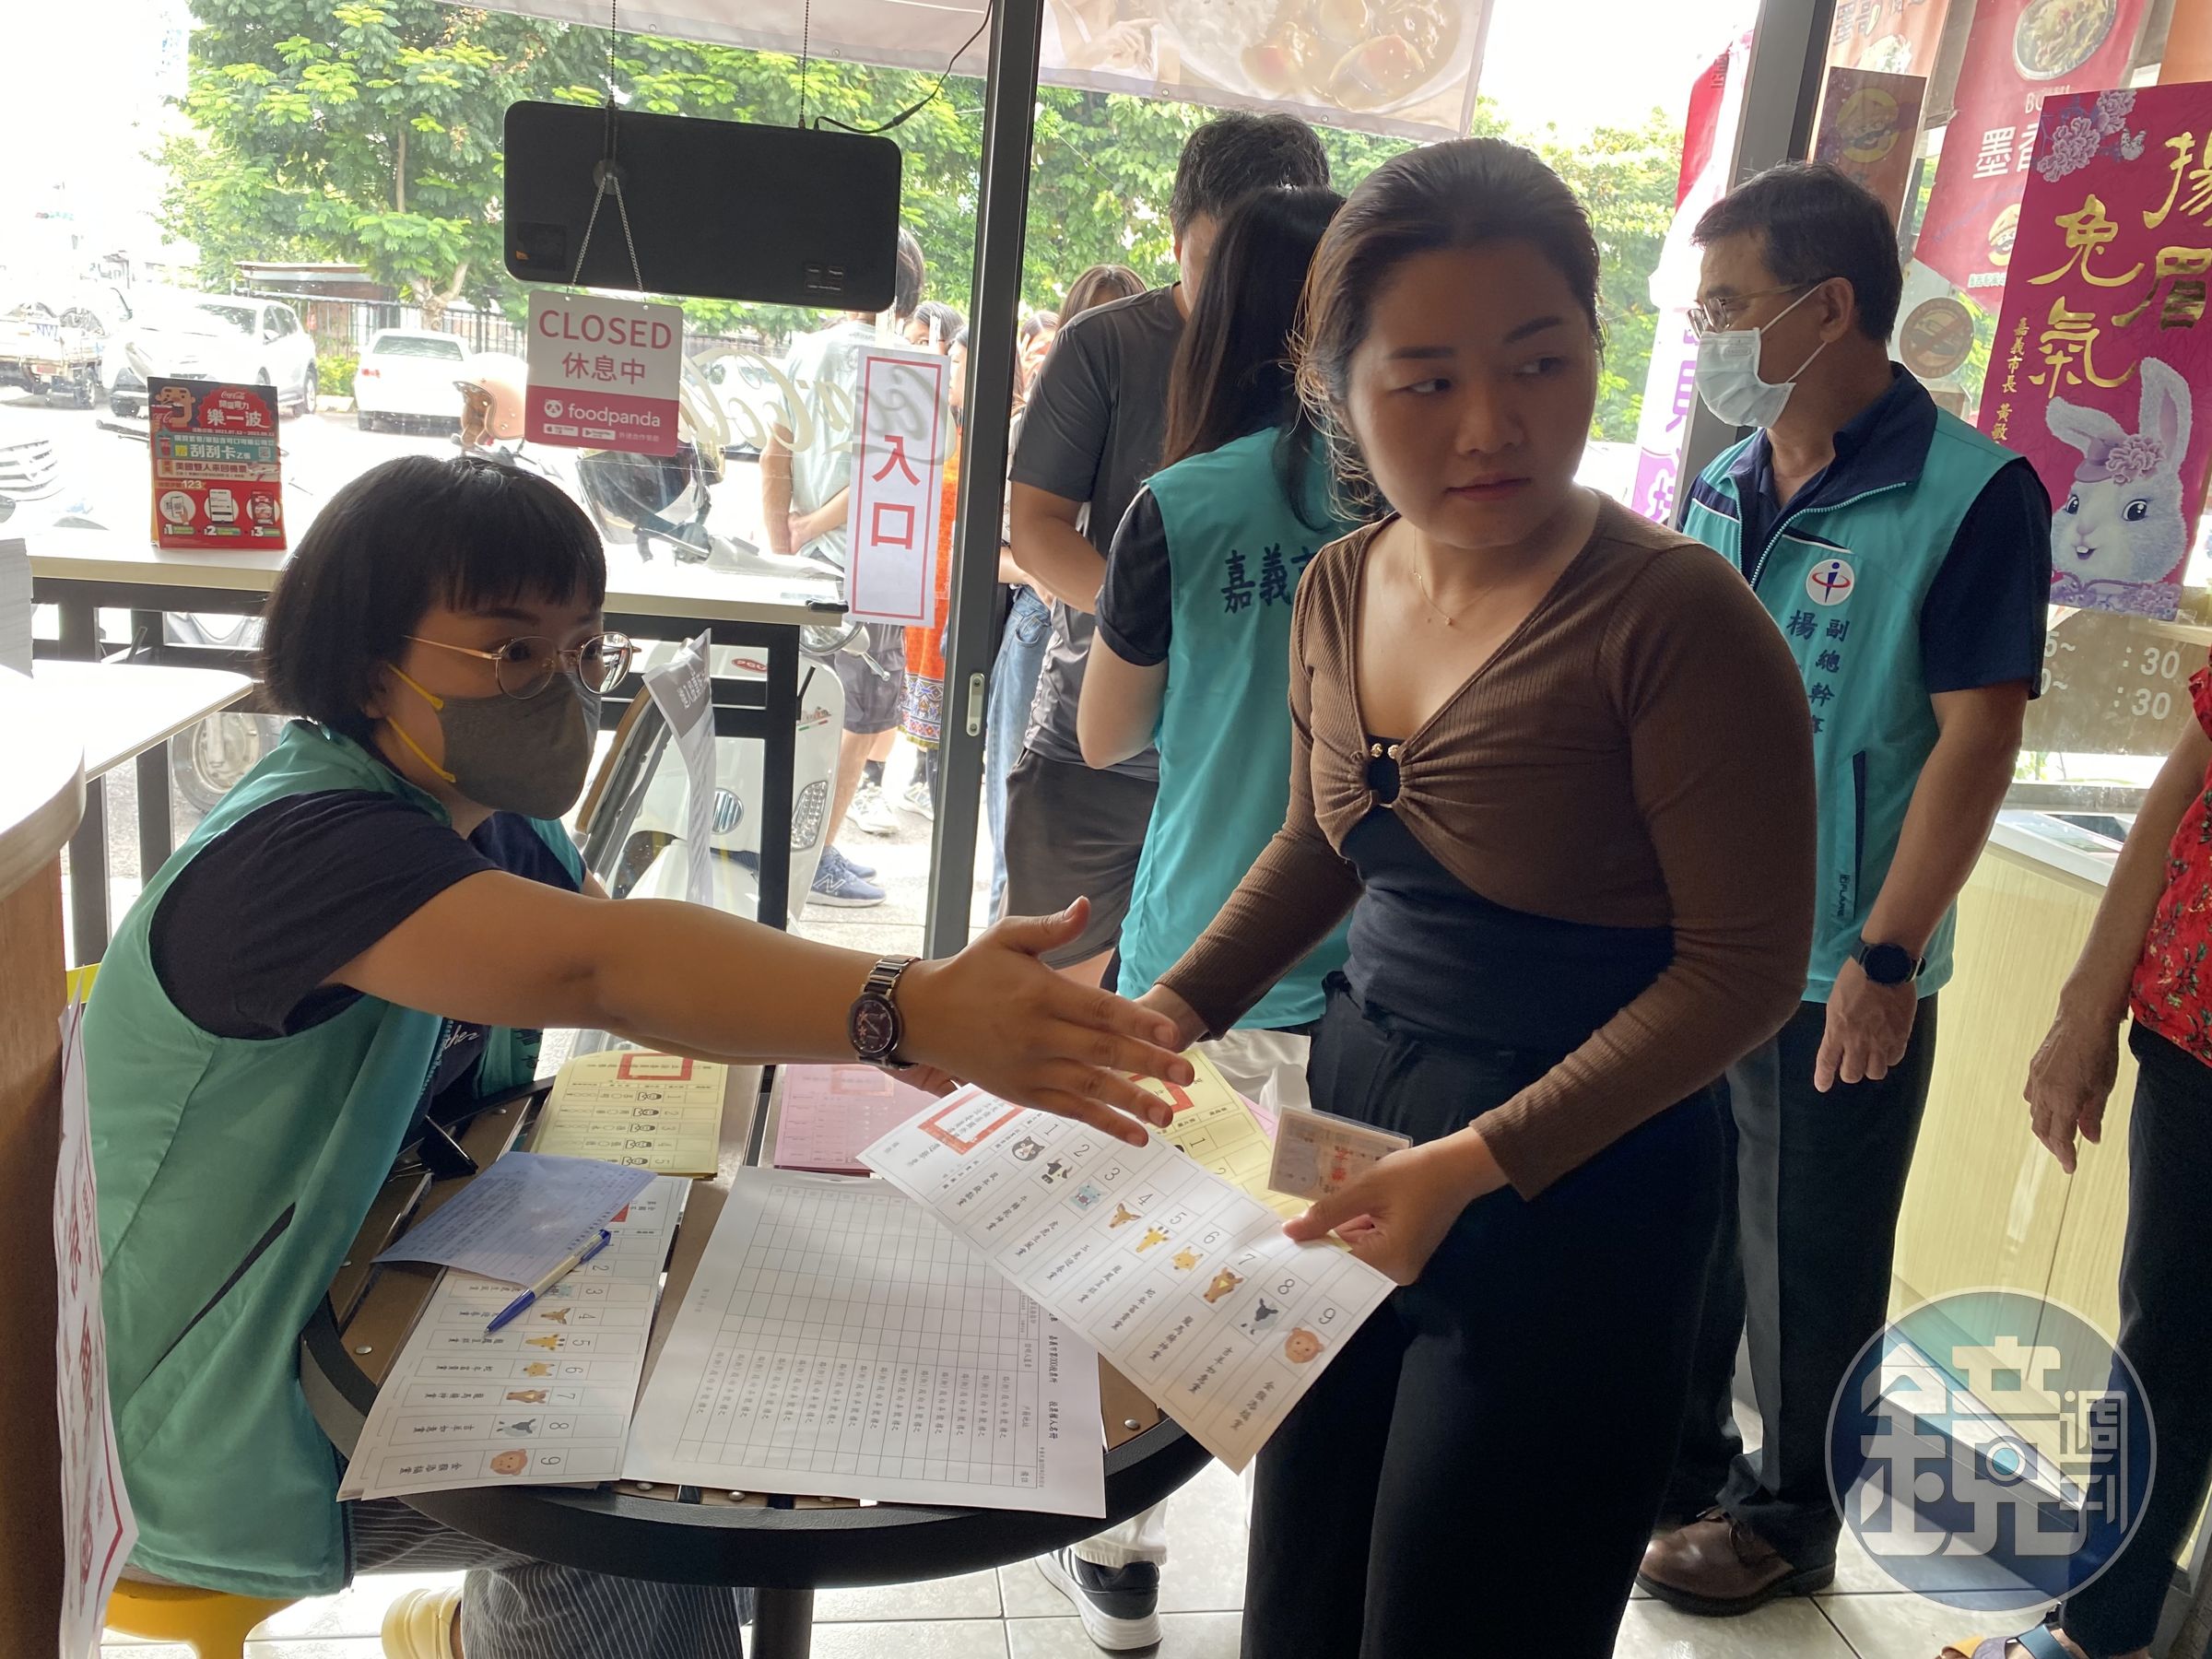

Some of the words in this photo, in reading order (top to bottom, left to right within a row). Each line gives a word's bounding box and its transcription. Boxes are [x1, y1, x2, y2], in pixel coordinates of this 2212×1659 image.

[539, 310, 672, 349] CLOSED
[2002, 316, 2030, 394] 嘉義市長
[561, 352, 645, 385] 休息中
[206, 408, 271, 429] 樂一波
[568, 403, 661, 428] foodpanda
[1991, 403, 2013, 442] 黃敏
[871, 434, 921, 550] 入口
[1786, 609, 1818, 641] 楊
[1044, 1124, 1059, 1135] 1
[1190, 1137, 1206, 1148] 1
[1073, 1144, 1090, 1158] 2
[1104, 1167, 1121, 1182] 3
[1138, 1193, 1153, 1206] 4
[1170, 1212, 1187, 1225] 5
[1204, 1230, 1220, 1244] 6
[1238, 1253, 1256, 1265] 7
[1277, 1278, 1296, 1295] 8
[1318, 1308, 1336, 1325] 9
[549, 1421, 569, 1430] 8
[540, 1456, 561, 1466] 9
